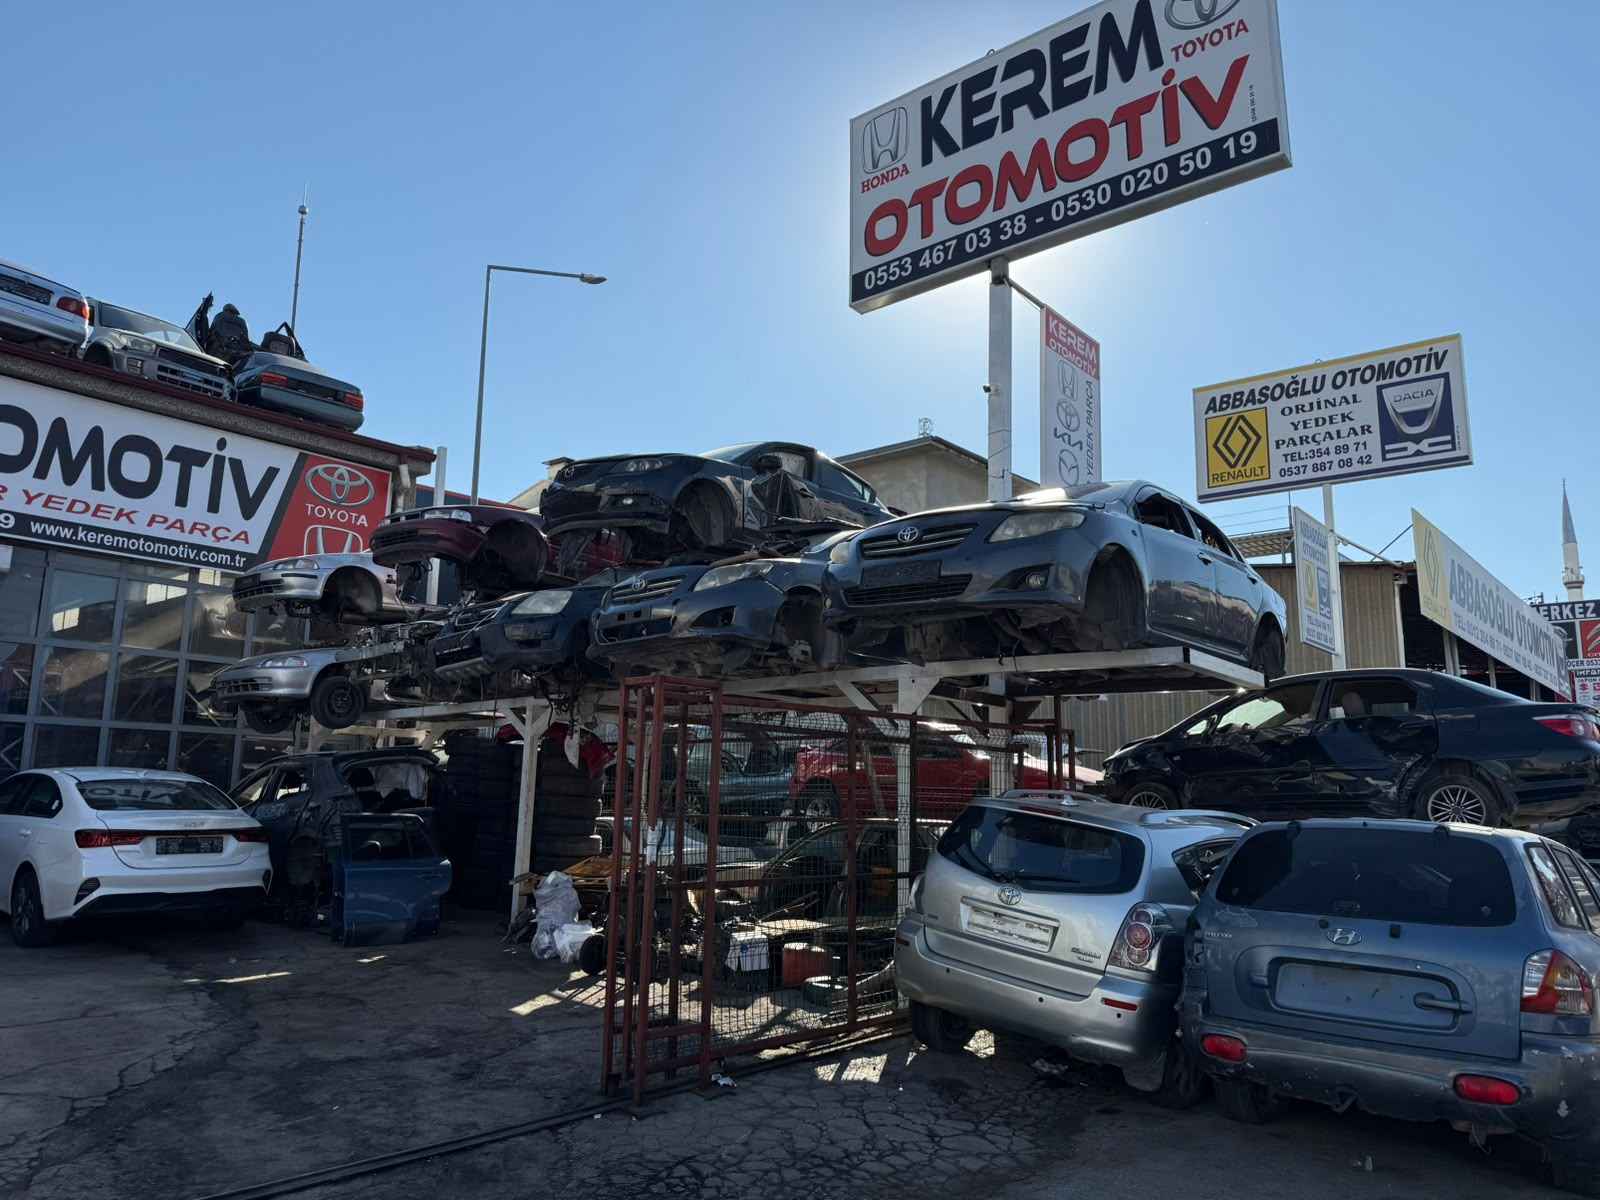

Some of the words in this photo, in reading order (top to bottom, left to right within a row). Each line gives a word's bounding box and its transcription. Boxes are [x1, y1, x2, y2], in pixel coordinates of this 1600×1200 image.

[1170, 19, 1250, 63] TOYOTA
[921, 0, 1165, 167] KEREM
[864, 54, 1250, 257] OTOMOTİV
[860, 163, 910, 194] HONDA
[864, 256, 913, 290] 0553
[919, 239, 957, 269] 467
[965, 227, 992, 252] 03
[1000, 214, 1027, 241] 38
[1051, 183, 1112, 222] 0530
[1120, 162, 1169, 196] 020
[1179, 147, 1212, 176] 50
[1223, 130, 1258, 159] 19
[1049, 315, 1097, 363] KEREM
[1204, 374, 1327, 416] ABBASOĞLU
[1332, 347, 1449, 390] OTOMOTİV
[1393, 388, 1435, 403] DACIA
[1274, 424, 1373, 449] PARÇALAR
[1290, 411, 1355, 431] YEDEK
[1334, 443, 1350, 455] 89
[1353, 441, 1368, 452] 71
[1211, 465, 1266, 484] RENAULT
[1279, 464, 1308, 478] 0537
[1338, 457, 1353, 468] 08
[1356, 454, 1373, 465] 42
[22, 489, 141, 525] YEDEK
[146, 513, 251, 546] PARÇA
[304, 503, 369, 528] TOYOTA
[30, 519, 247, 569] www.keremotomotiv.com.tr
[1540, 602, 1597, 620] ERKEZ
